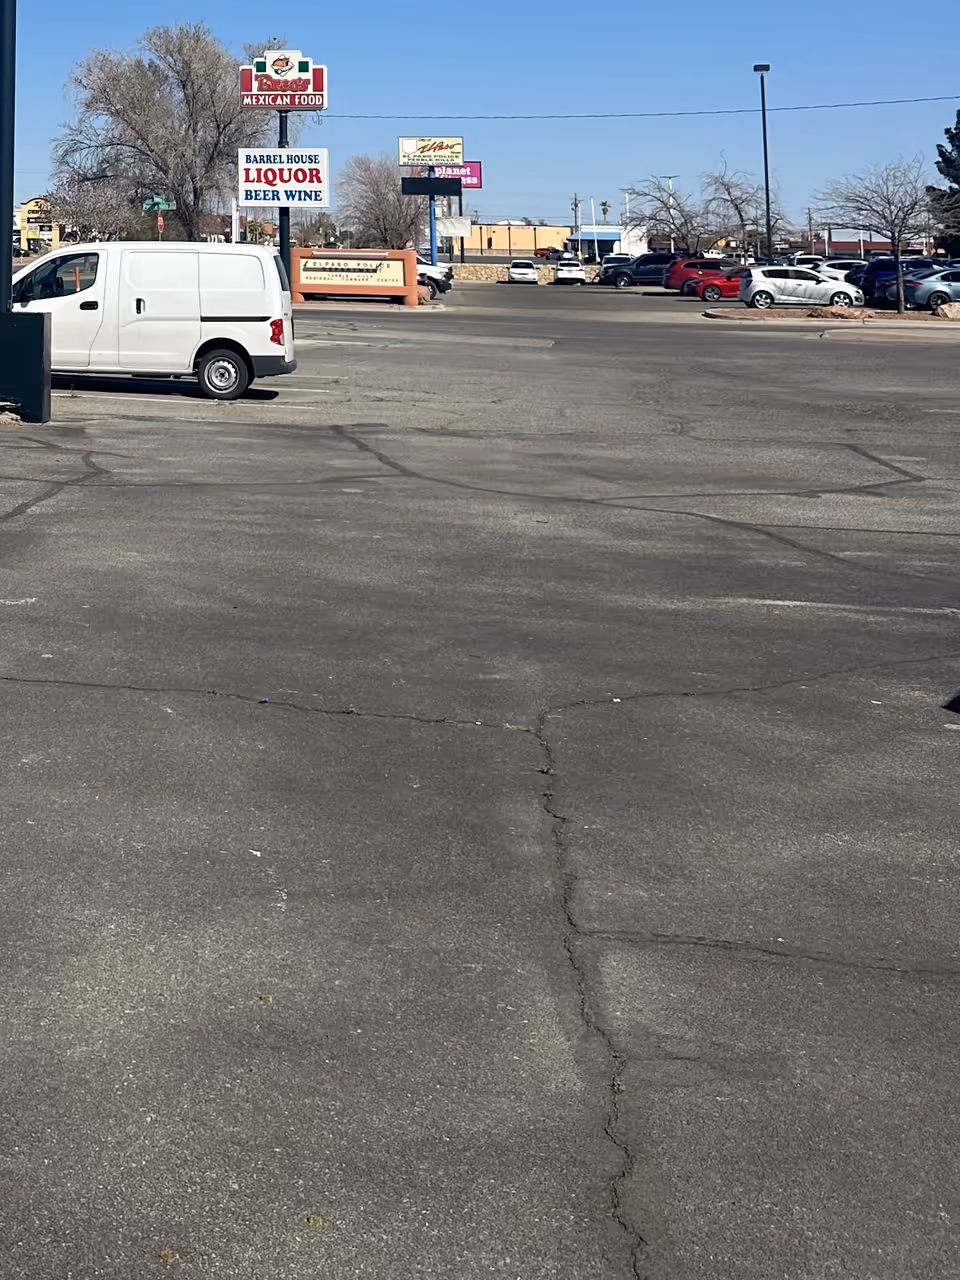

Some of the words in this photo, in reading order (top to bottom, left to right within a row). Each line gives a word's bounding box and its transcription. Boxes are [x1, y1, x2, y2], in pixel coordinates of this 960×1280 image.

[243, 95, 290, 105] MEXICAN
[295, 95, 323, 105] FOOD
[245, 154, 284, 164] BARREL
[286, 154, 320, 164] HOUSE
[435, 166, 471, 176] planet
[243, 168, 322, 187] LIQUOR
[244, 189, 280, 201] BEER
[284, 190, 322, 201] WINE
